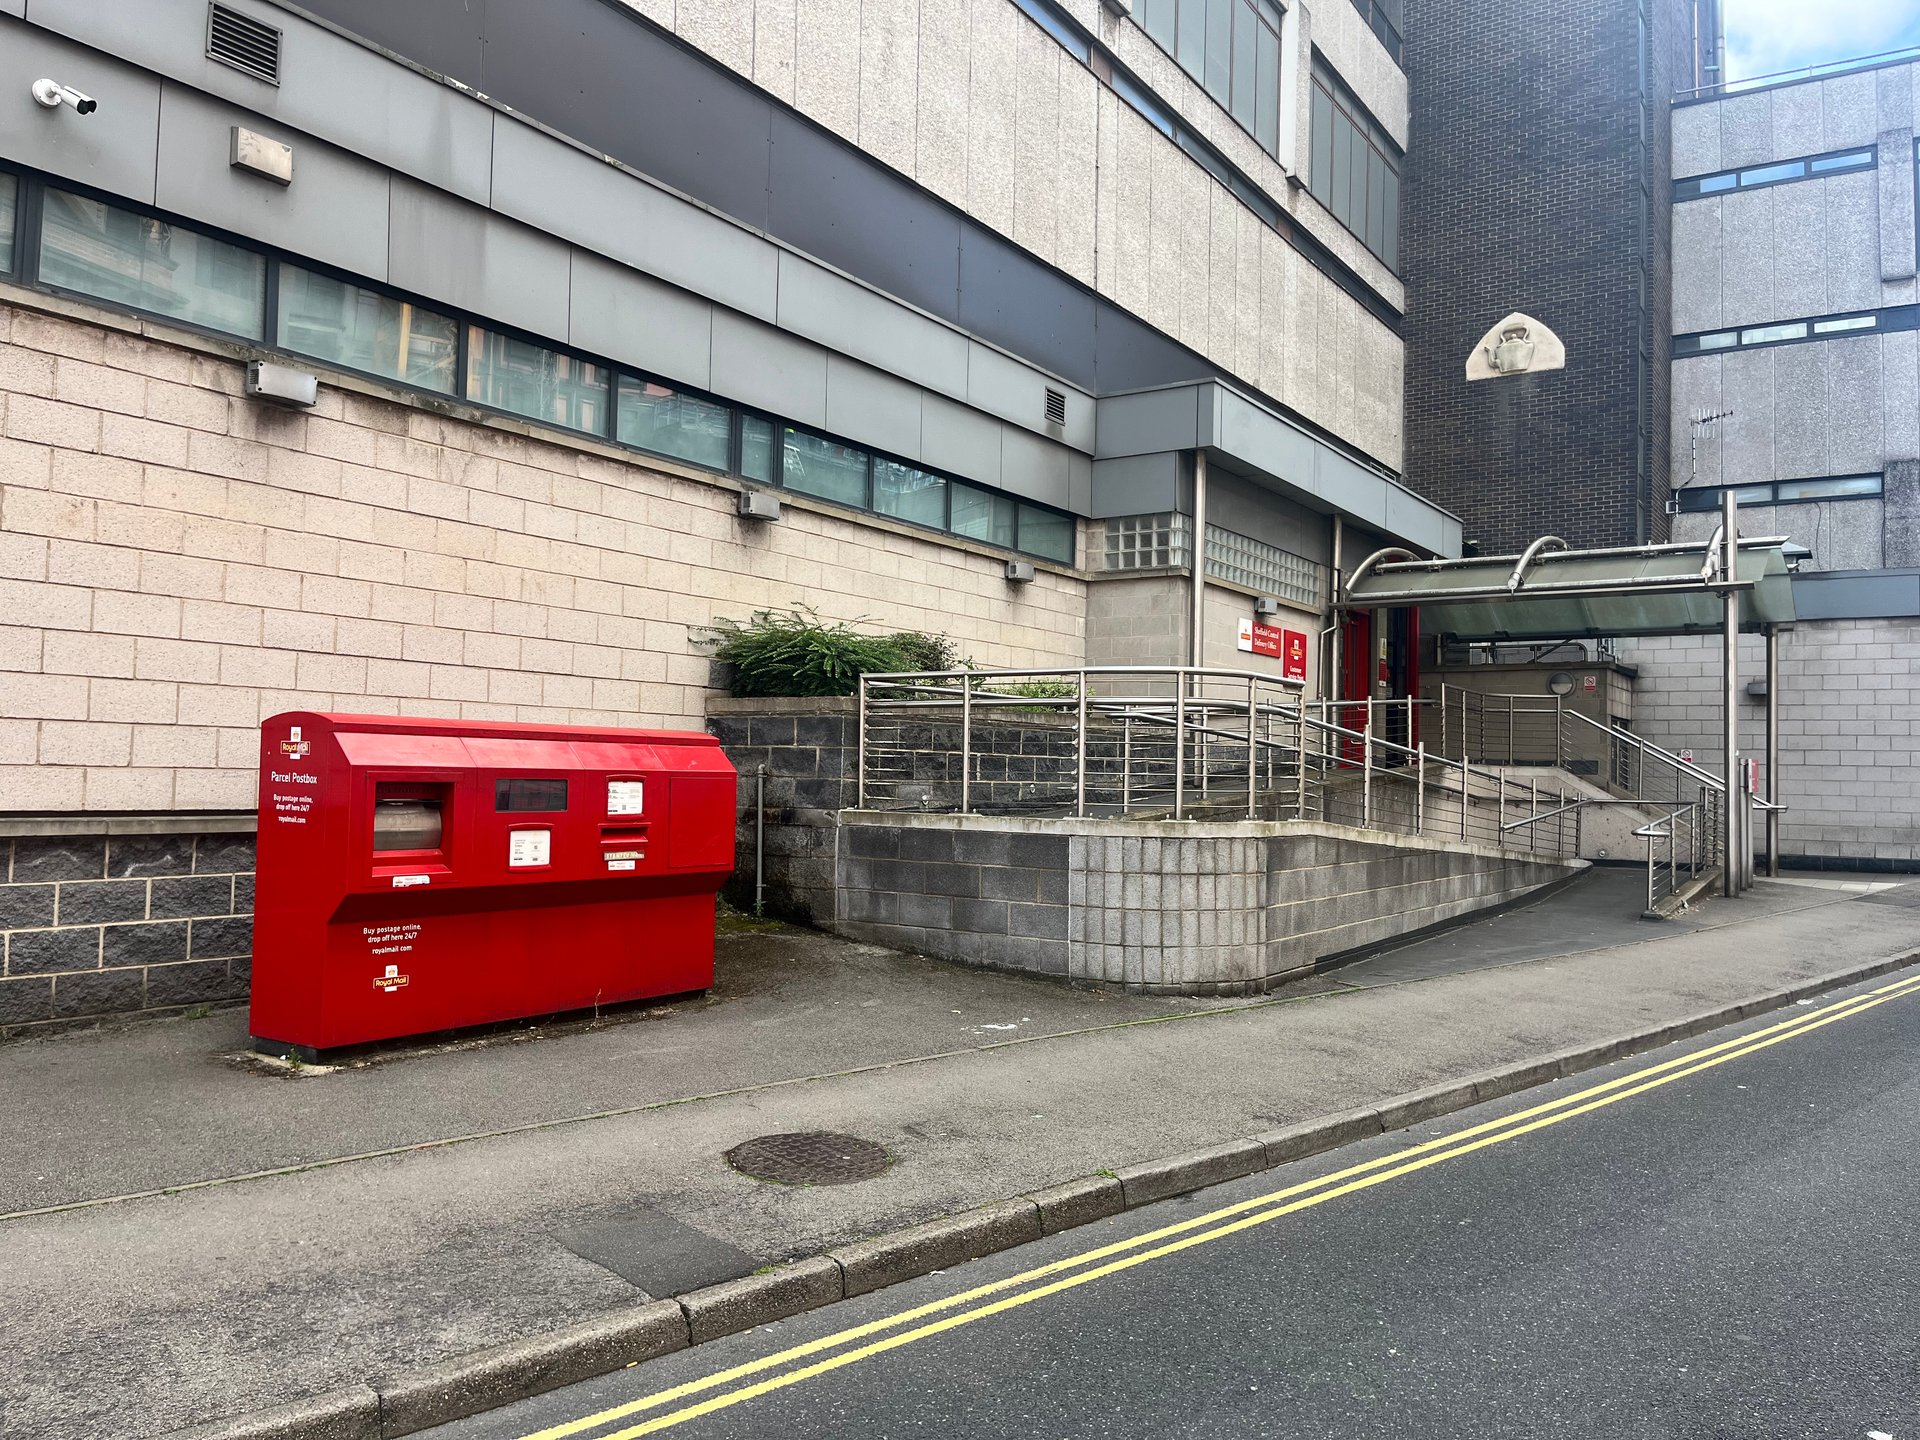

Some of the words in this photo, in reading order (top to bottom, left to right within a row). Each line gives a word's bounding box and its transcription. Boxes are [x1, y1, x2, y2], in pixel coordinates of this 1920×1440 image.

[1255, 627, 1267, 636] Sheffield
[1267, 630, 1279, 639] Central
[1255, 638, 1267, 650] Delivery
[1267, 641, 1277, 650] Office
[283, 742, 297, 752] Royal
[271, 771, 291, 783] Parcel
[292, 772, 317, 785] Postbox
[273, 794, 281, 802] Buy
[282, 795, 298, 804] postage
[275, 803, 285, 811] drop
[291, 804, 300, 812] here
[278, 815, 306, 823] royalmail.com
[363, 927, 375, 935] Buy
[376, 926, 401, 934] postage
[382, 934, 390, 942] off
[404, 932, 418, 940] 24/7
[375, 978, 393, 987] Royal
[393, 976, 407, 985] Mail
